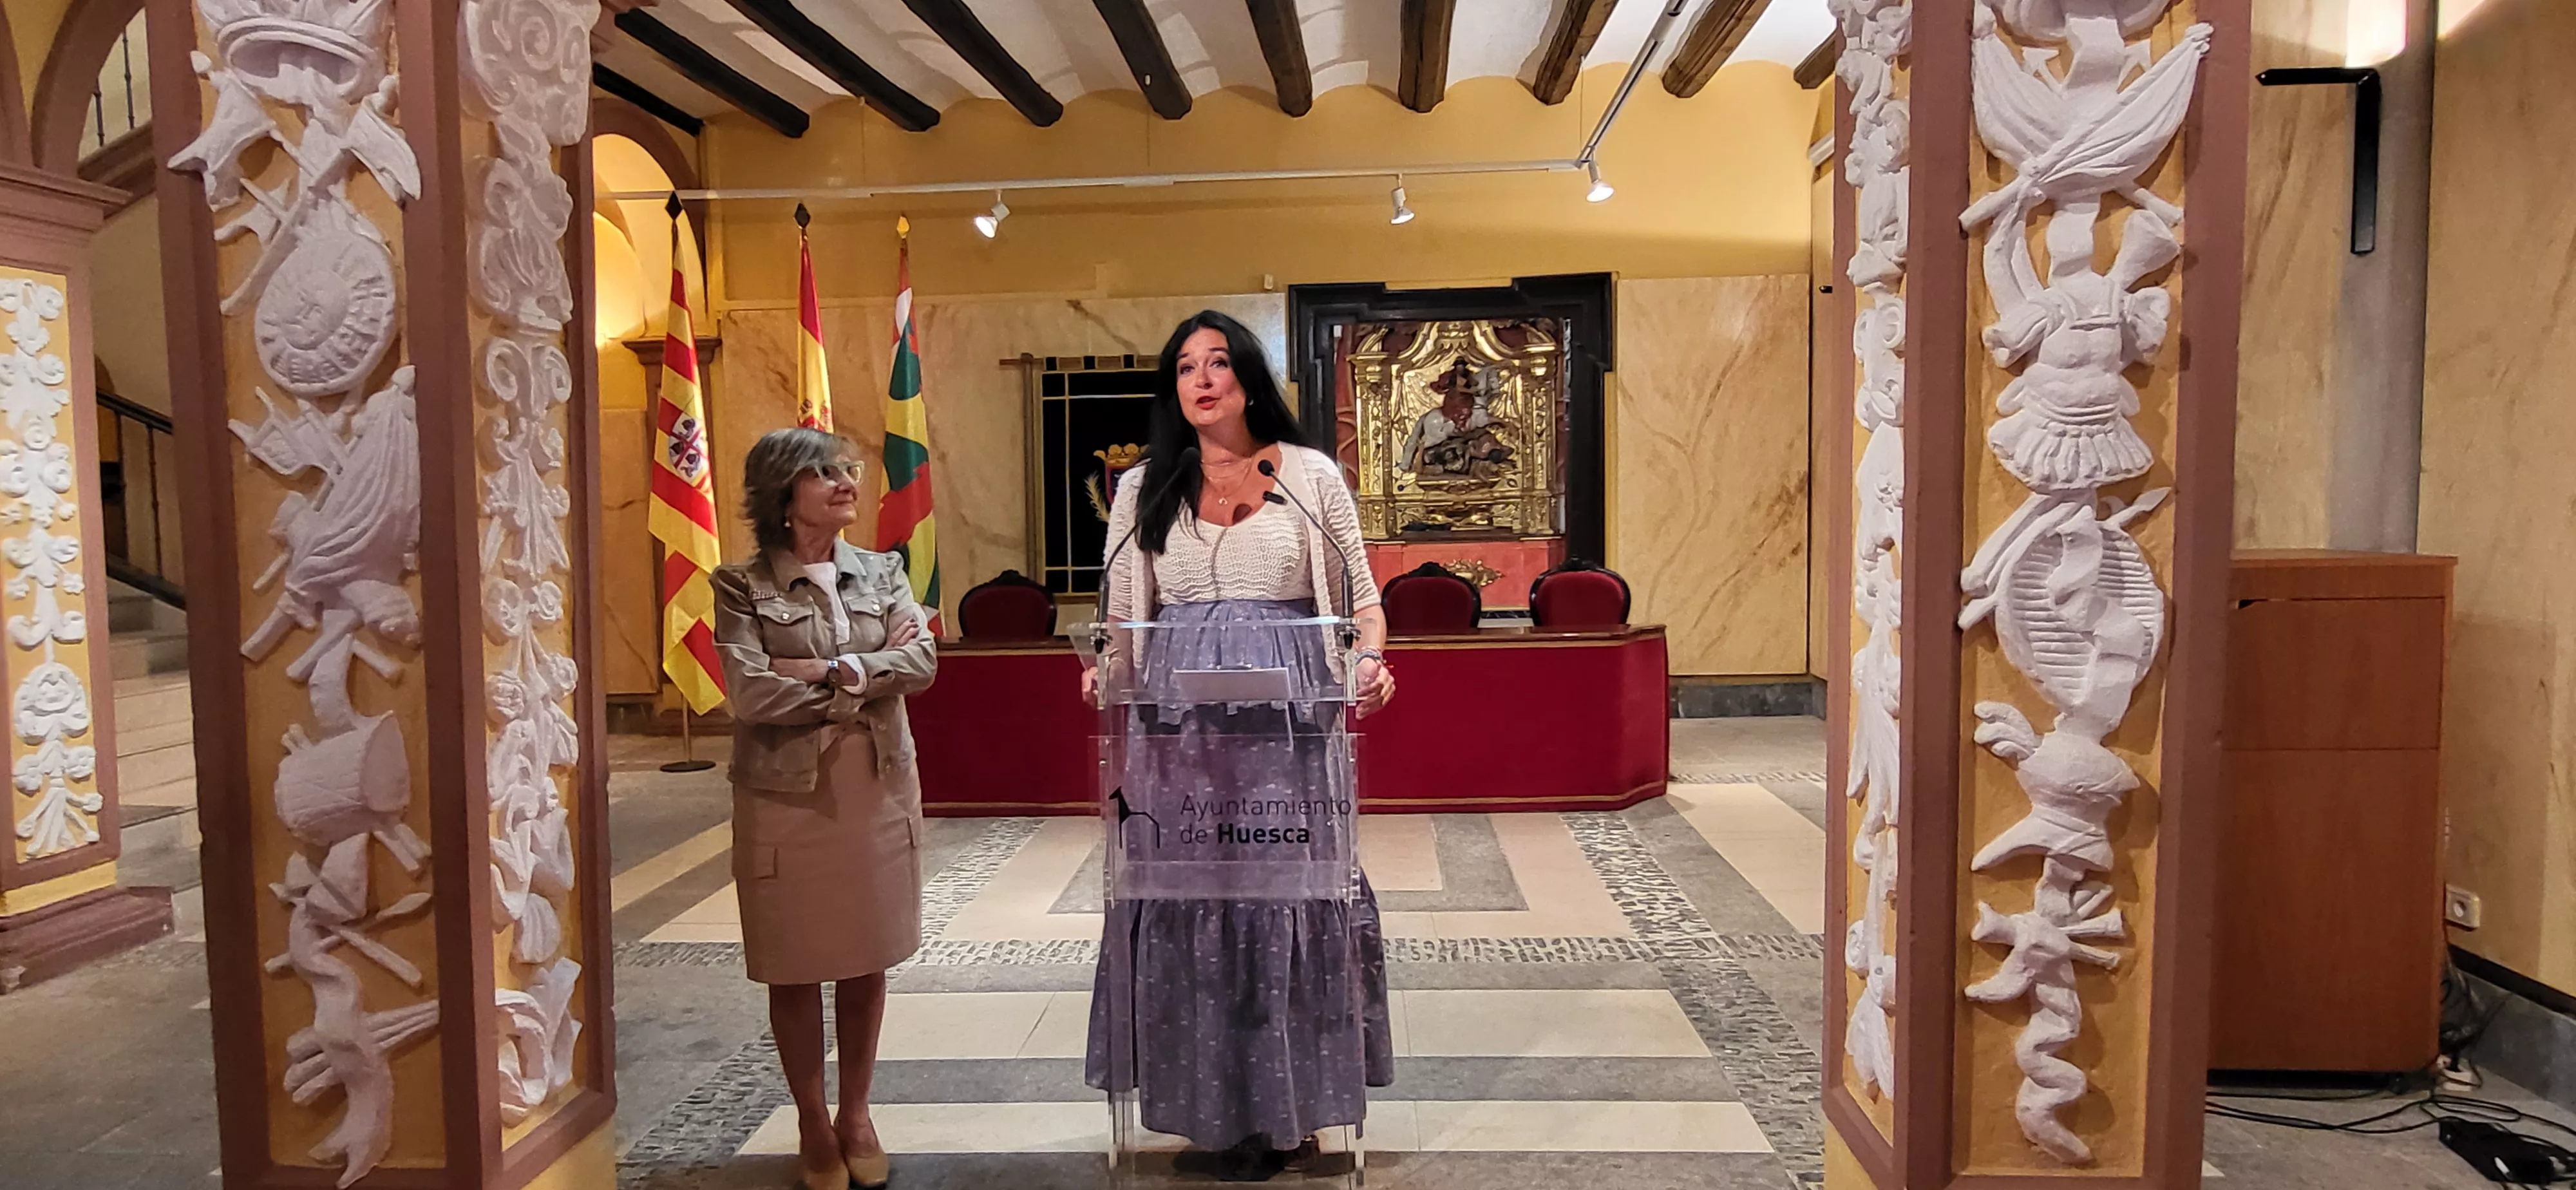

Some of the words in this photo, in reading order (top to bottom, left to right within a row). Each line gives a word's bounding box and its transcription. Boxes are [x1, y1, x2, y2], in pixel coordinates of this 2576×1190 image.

[1180, 795, 1351, 821] Ayuntamiento
[1180, 824, 1208, 844] de
[1218, 824, 1310, 844] Huesca
